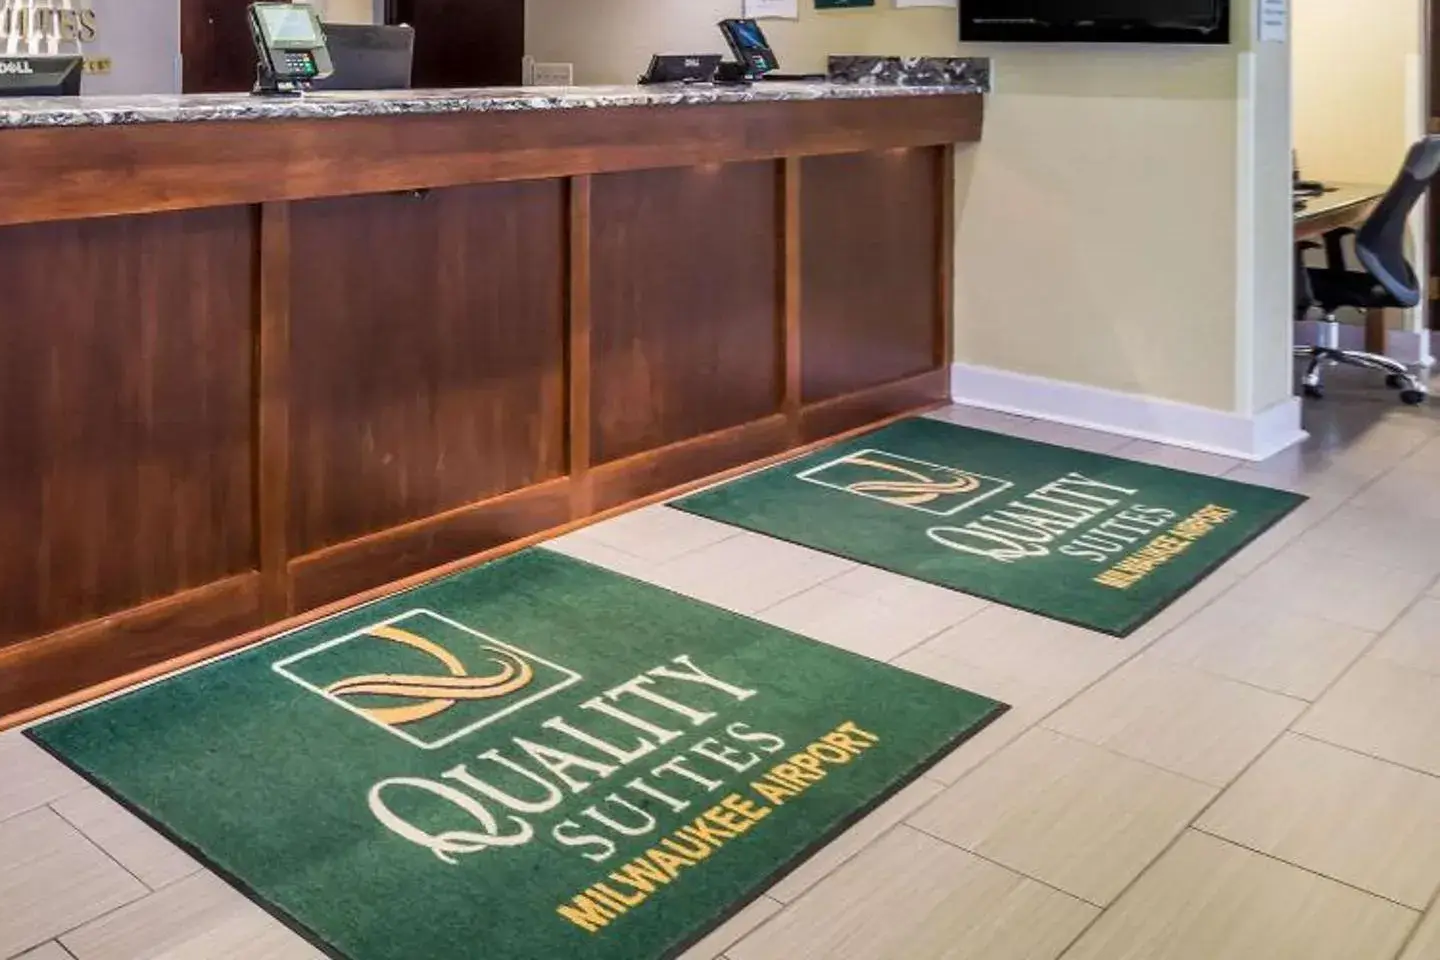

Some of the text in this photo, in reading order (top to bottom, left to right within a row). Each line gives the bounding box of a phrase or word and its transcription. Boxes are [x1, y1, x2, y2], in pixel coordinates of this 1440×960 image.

[926, 472, 1139, 563] QUALITY
[1059, 504, 1176, 562] SUITES
[368, 654, 759, 864] QUALITY
[552, 721, 785, 862] SUITES
[556, 720, 880, 933] MILWAUKEE AIRPORT
